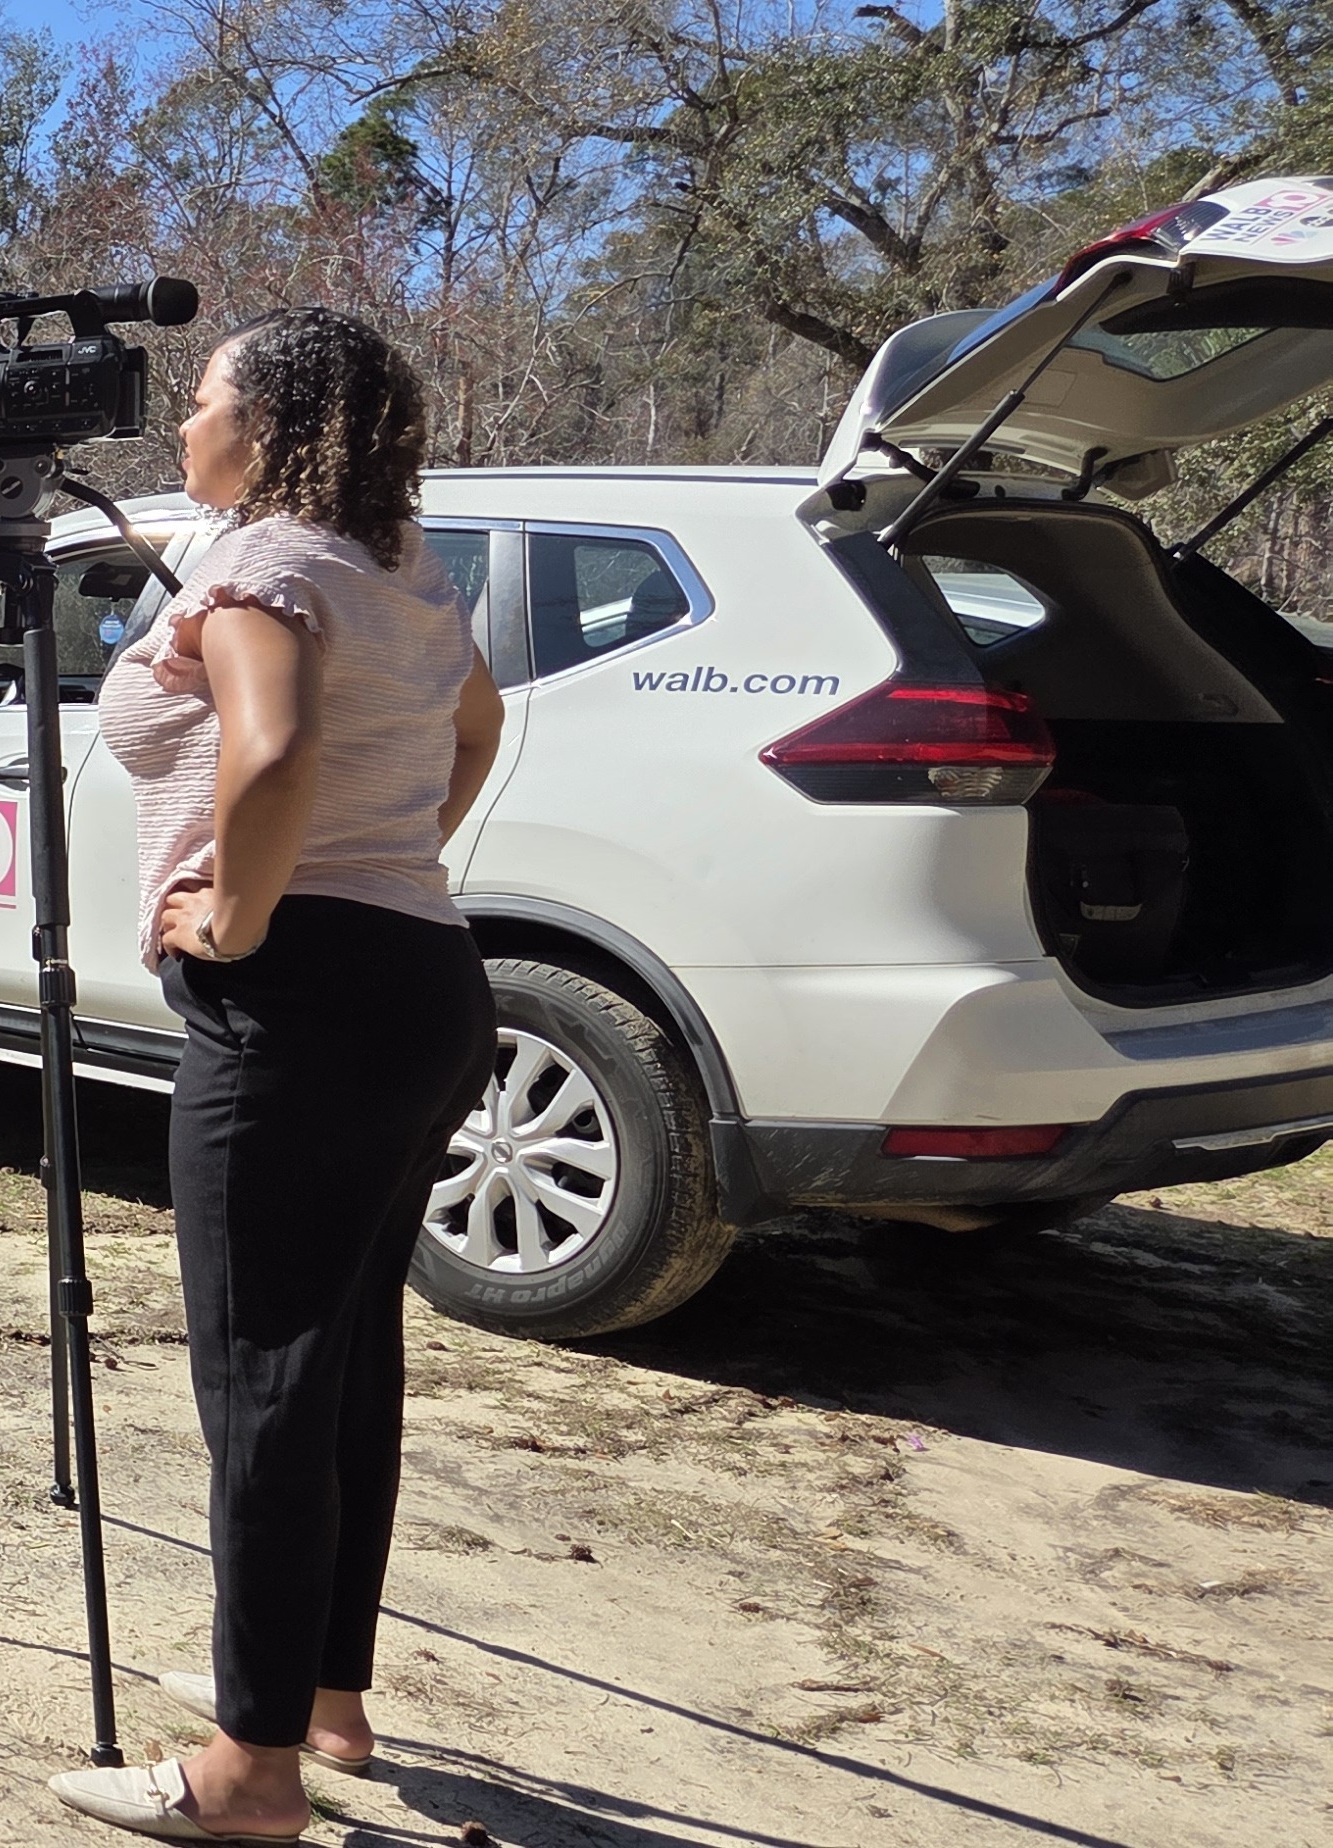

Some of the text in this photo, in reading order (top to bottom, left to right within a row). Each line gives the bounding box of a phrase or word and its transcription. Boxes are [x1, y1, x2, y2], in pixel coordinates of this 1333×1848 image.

[1200, 206, 1273, 242] WALB
[1233, 210, 1294, 243] NEWS
[77, 345, 97, 354] JVC
[633, 666, 840, 696] walb.com
